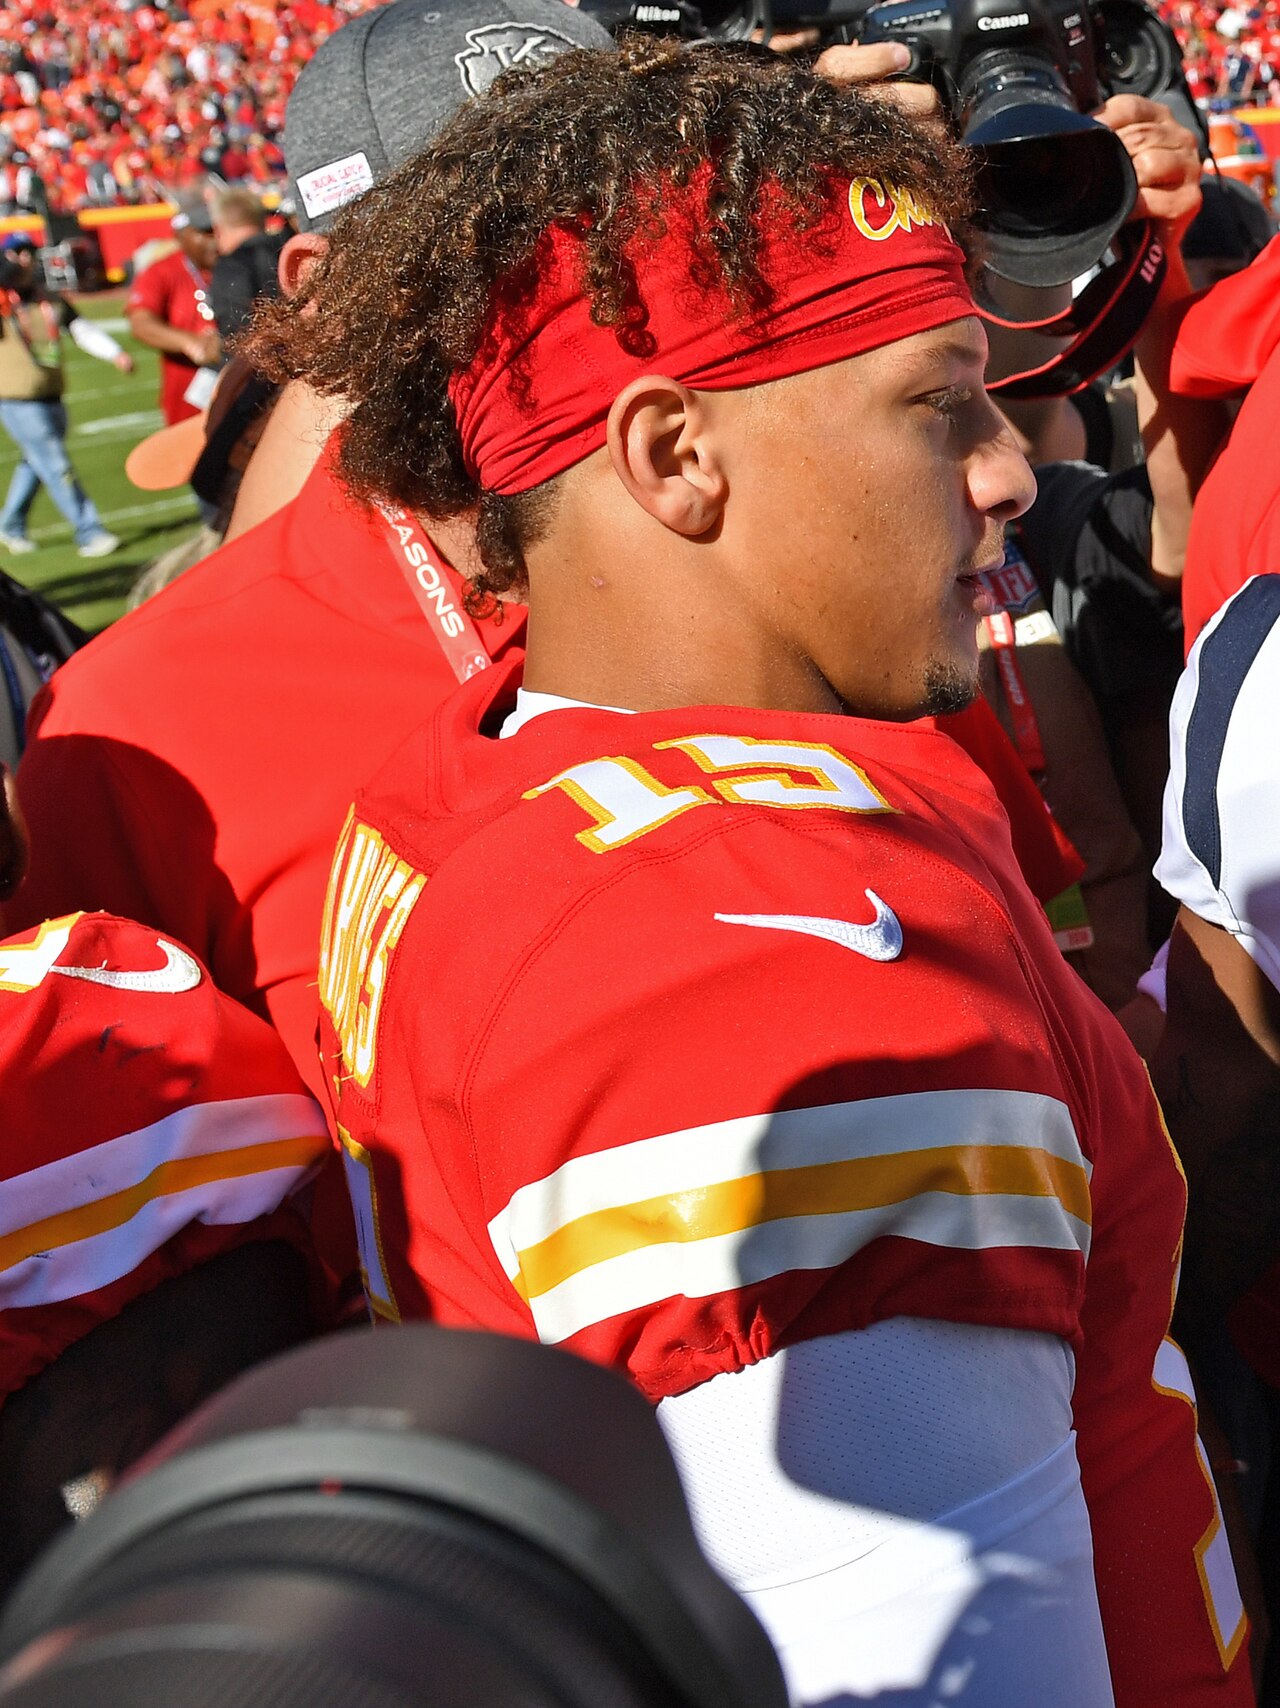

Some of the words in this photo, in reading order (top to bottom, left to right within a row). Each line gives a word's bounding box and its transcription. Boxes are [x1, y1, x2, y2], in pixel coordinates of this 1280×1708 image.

[636, 6, 680, 21] Nikon
[978, 13, 1029, 31] Canon
[520, 734, 905, 854] 15
